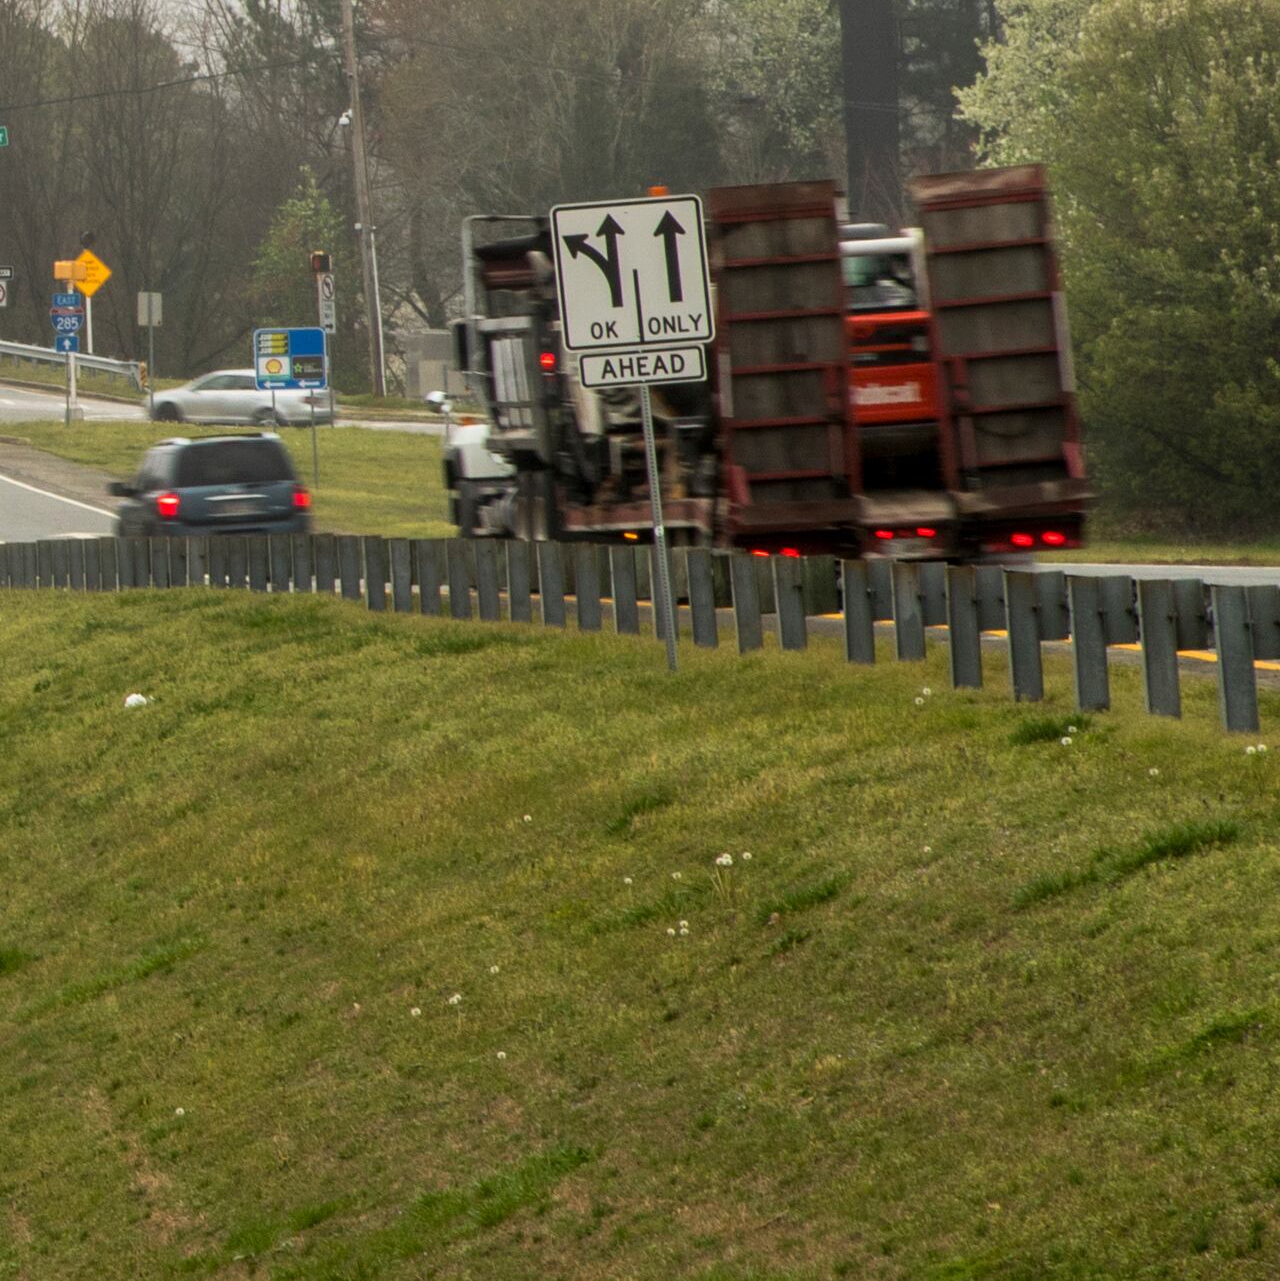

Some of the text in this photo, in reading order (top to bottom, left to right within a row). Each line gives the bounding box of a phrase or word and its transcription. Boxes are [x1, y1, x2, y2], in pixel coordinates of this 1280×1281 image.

[56, 295, 76, 306] EAST
[56, 317, 79, 330] 285
[590, 313, 703, 340] OK ONLY
[601, 353, 685, 380] AHEAD
